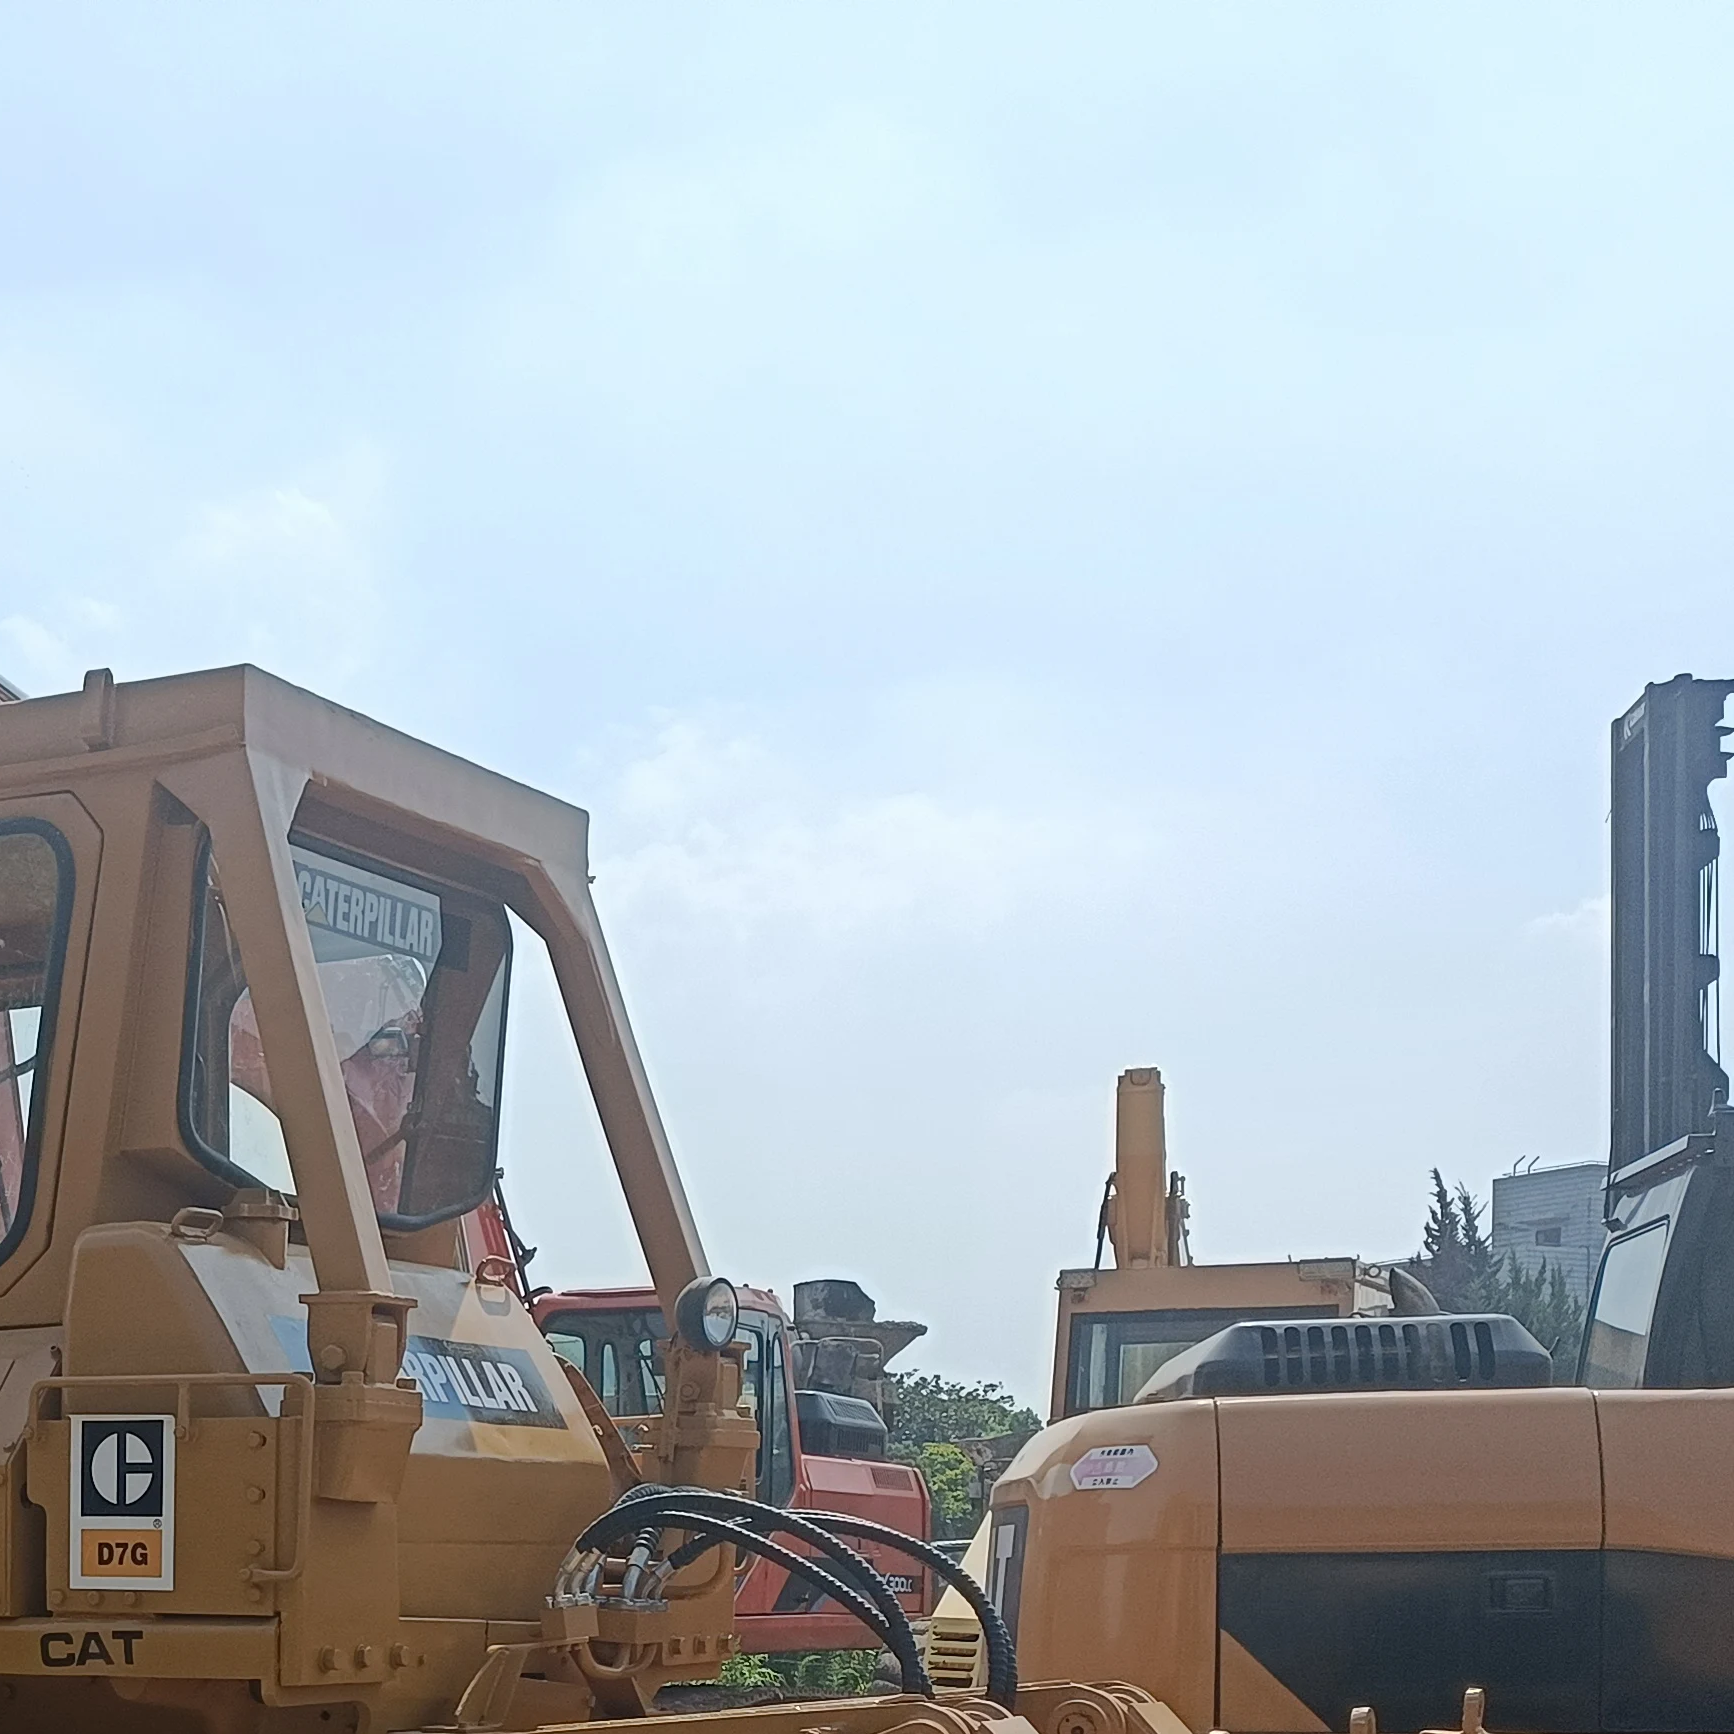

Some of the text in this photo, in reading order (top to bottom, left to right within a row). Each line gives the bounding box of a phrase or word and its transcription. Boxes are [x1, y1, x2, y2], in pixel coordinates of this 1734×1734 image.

[298, 870, 433, 957] CATERPILLAR
[402, 1350, 539, 1413] RPILLAR
[97, 1542, 148, 1566] D7G
[40, 1630, 144, 1667] CAT
